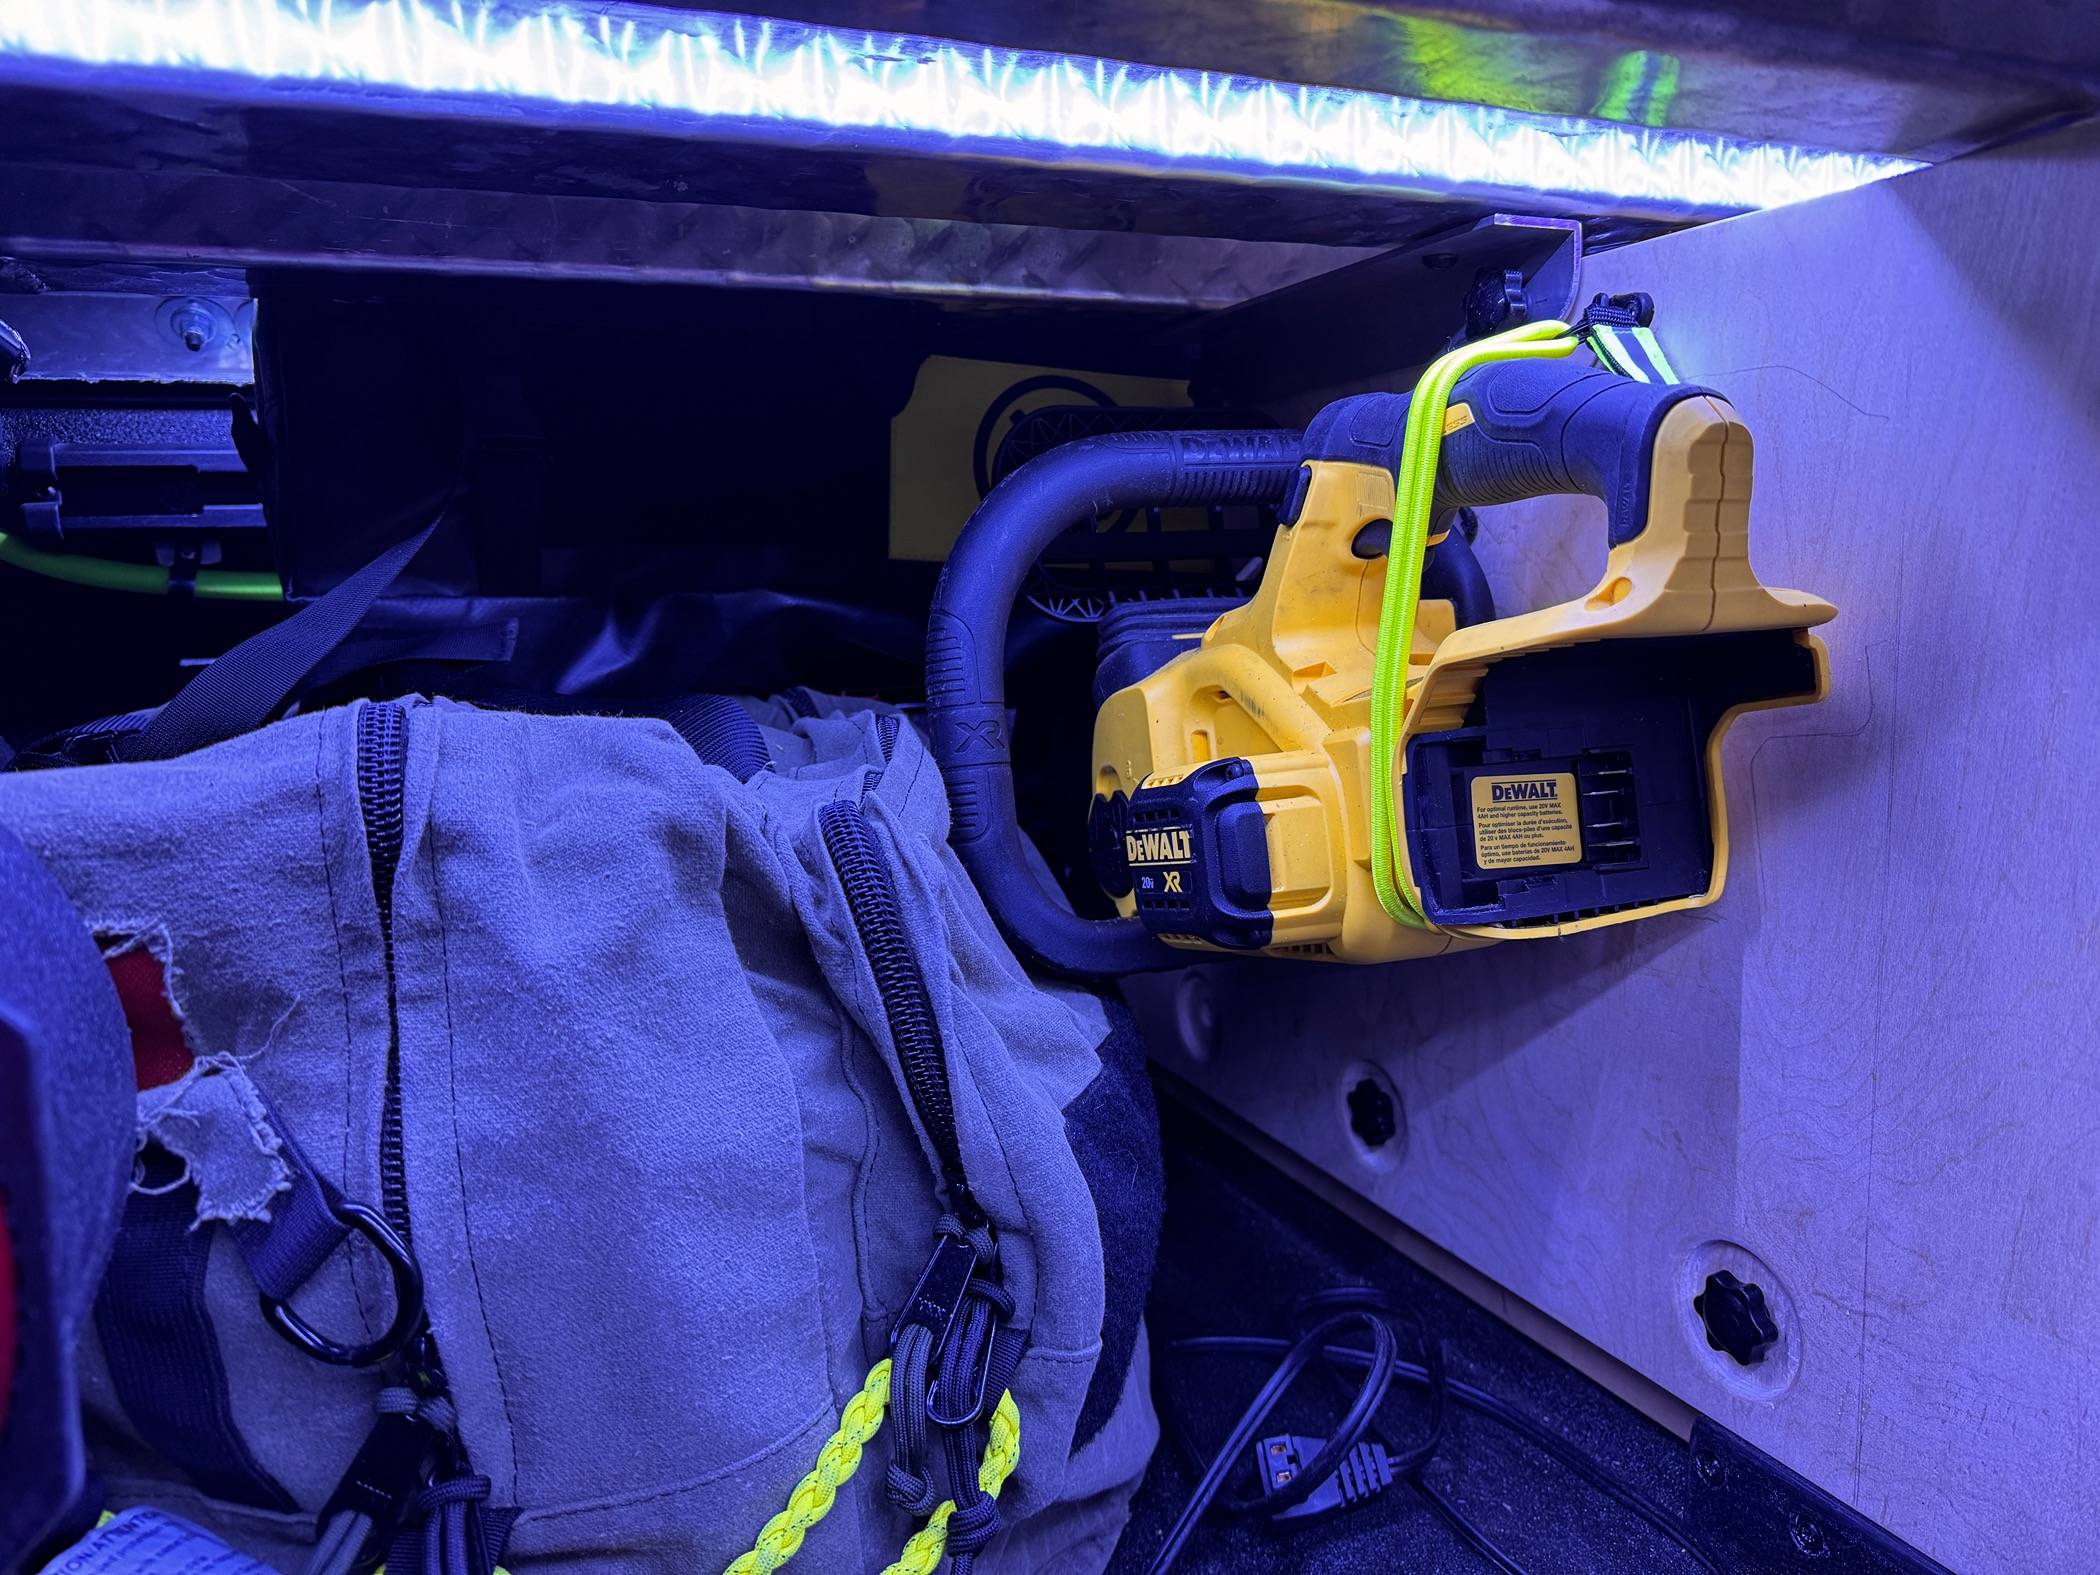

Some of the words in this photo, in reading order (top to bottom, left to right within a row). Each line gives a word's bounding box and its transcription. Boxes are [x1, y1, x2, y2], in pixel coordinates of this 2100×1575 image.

[1491, 782, 1558, 801] DEWALT
[1126, 832, 1192, 862] DEWALT
[1162, 871, 1183, 892] XR
